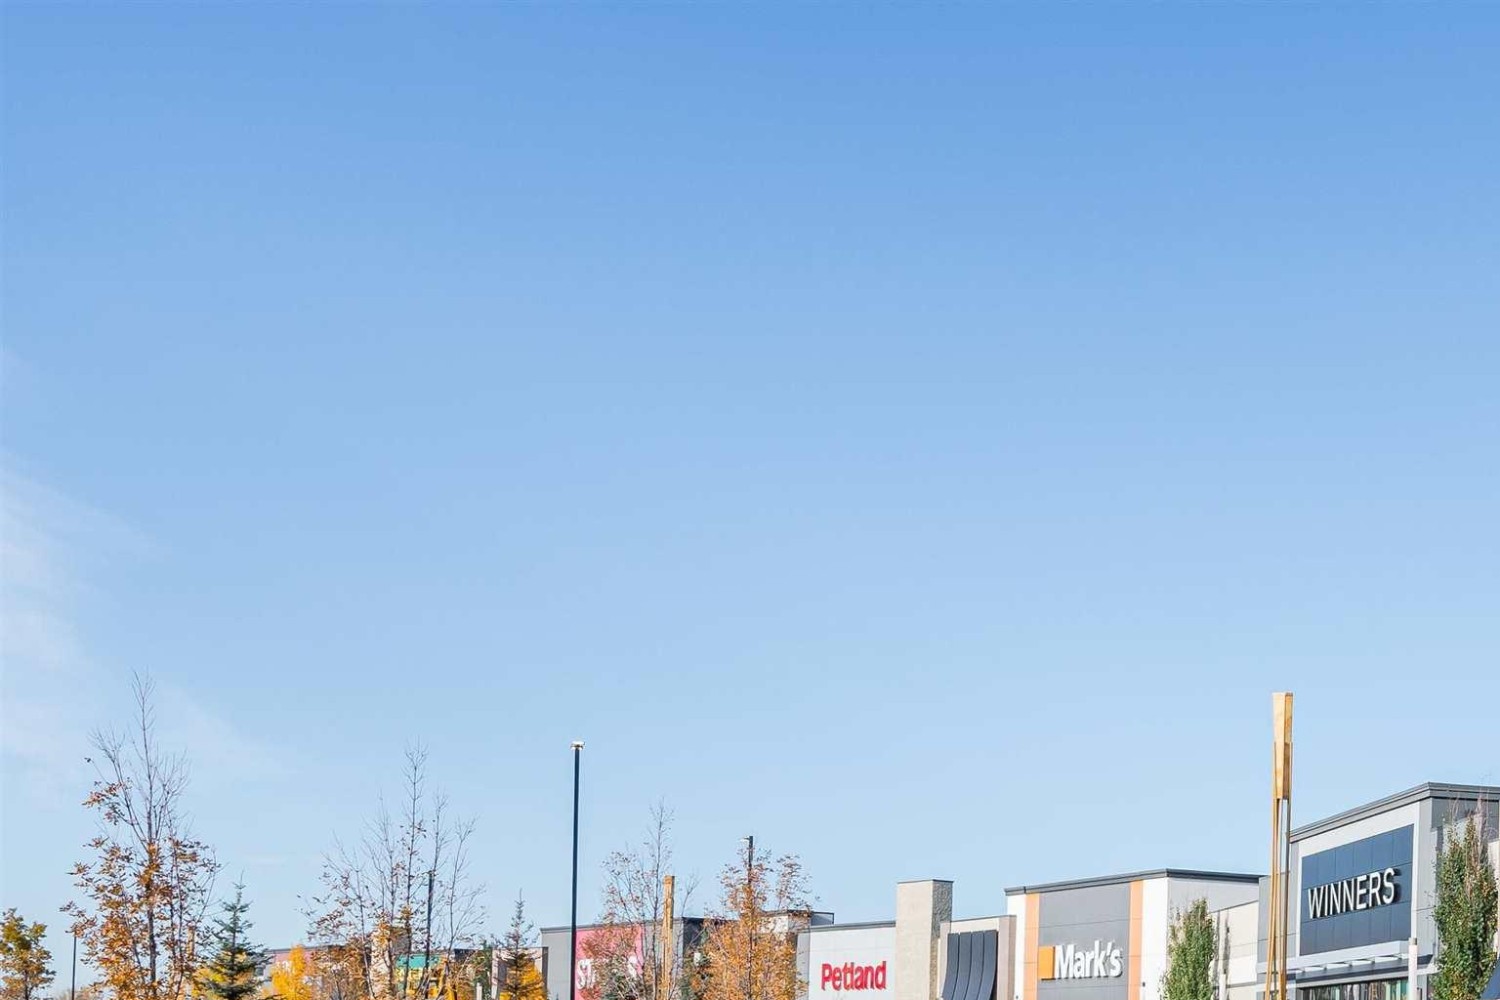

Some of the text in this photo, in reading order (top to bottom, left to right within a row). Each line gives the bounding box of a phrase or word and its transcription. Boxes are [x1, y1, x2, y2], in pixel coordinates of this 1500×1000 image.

[1308, 867, 1396, 919] WINNERS
[821, 961, 887, 991] Petland
[1054, 940, 1122, 979] Mark's
